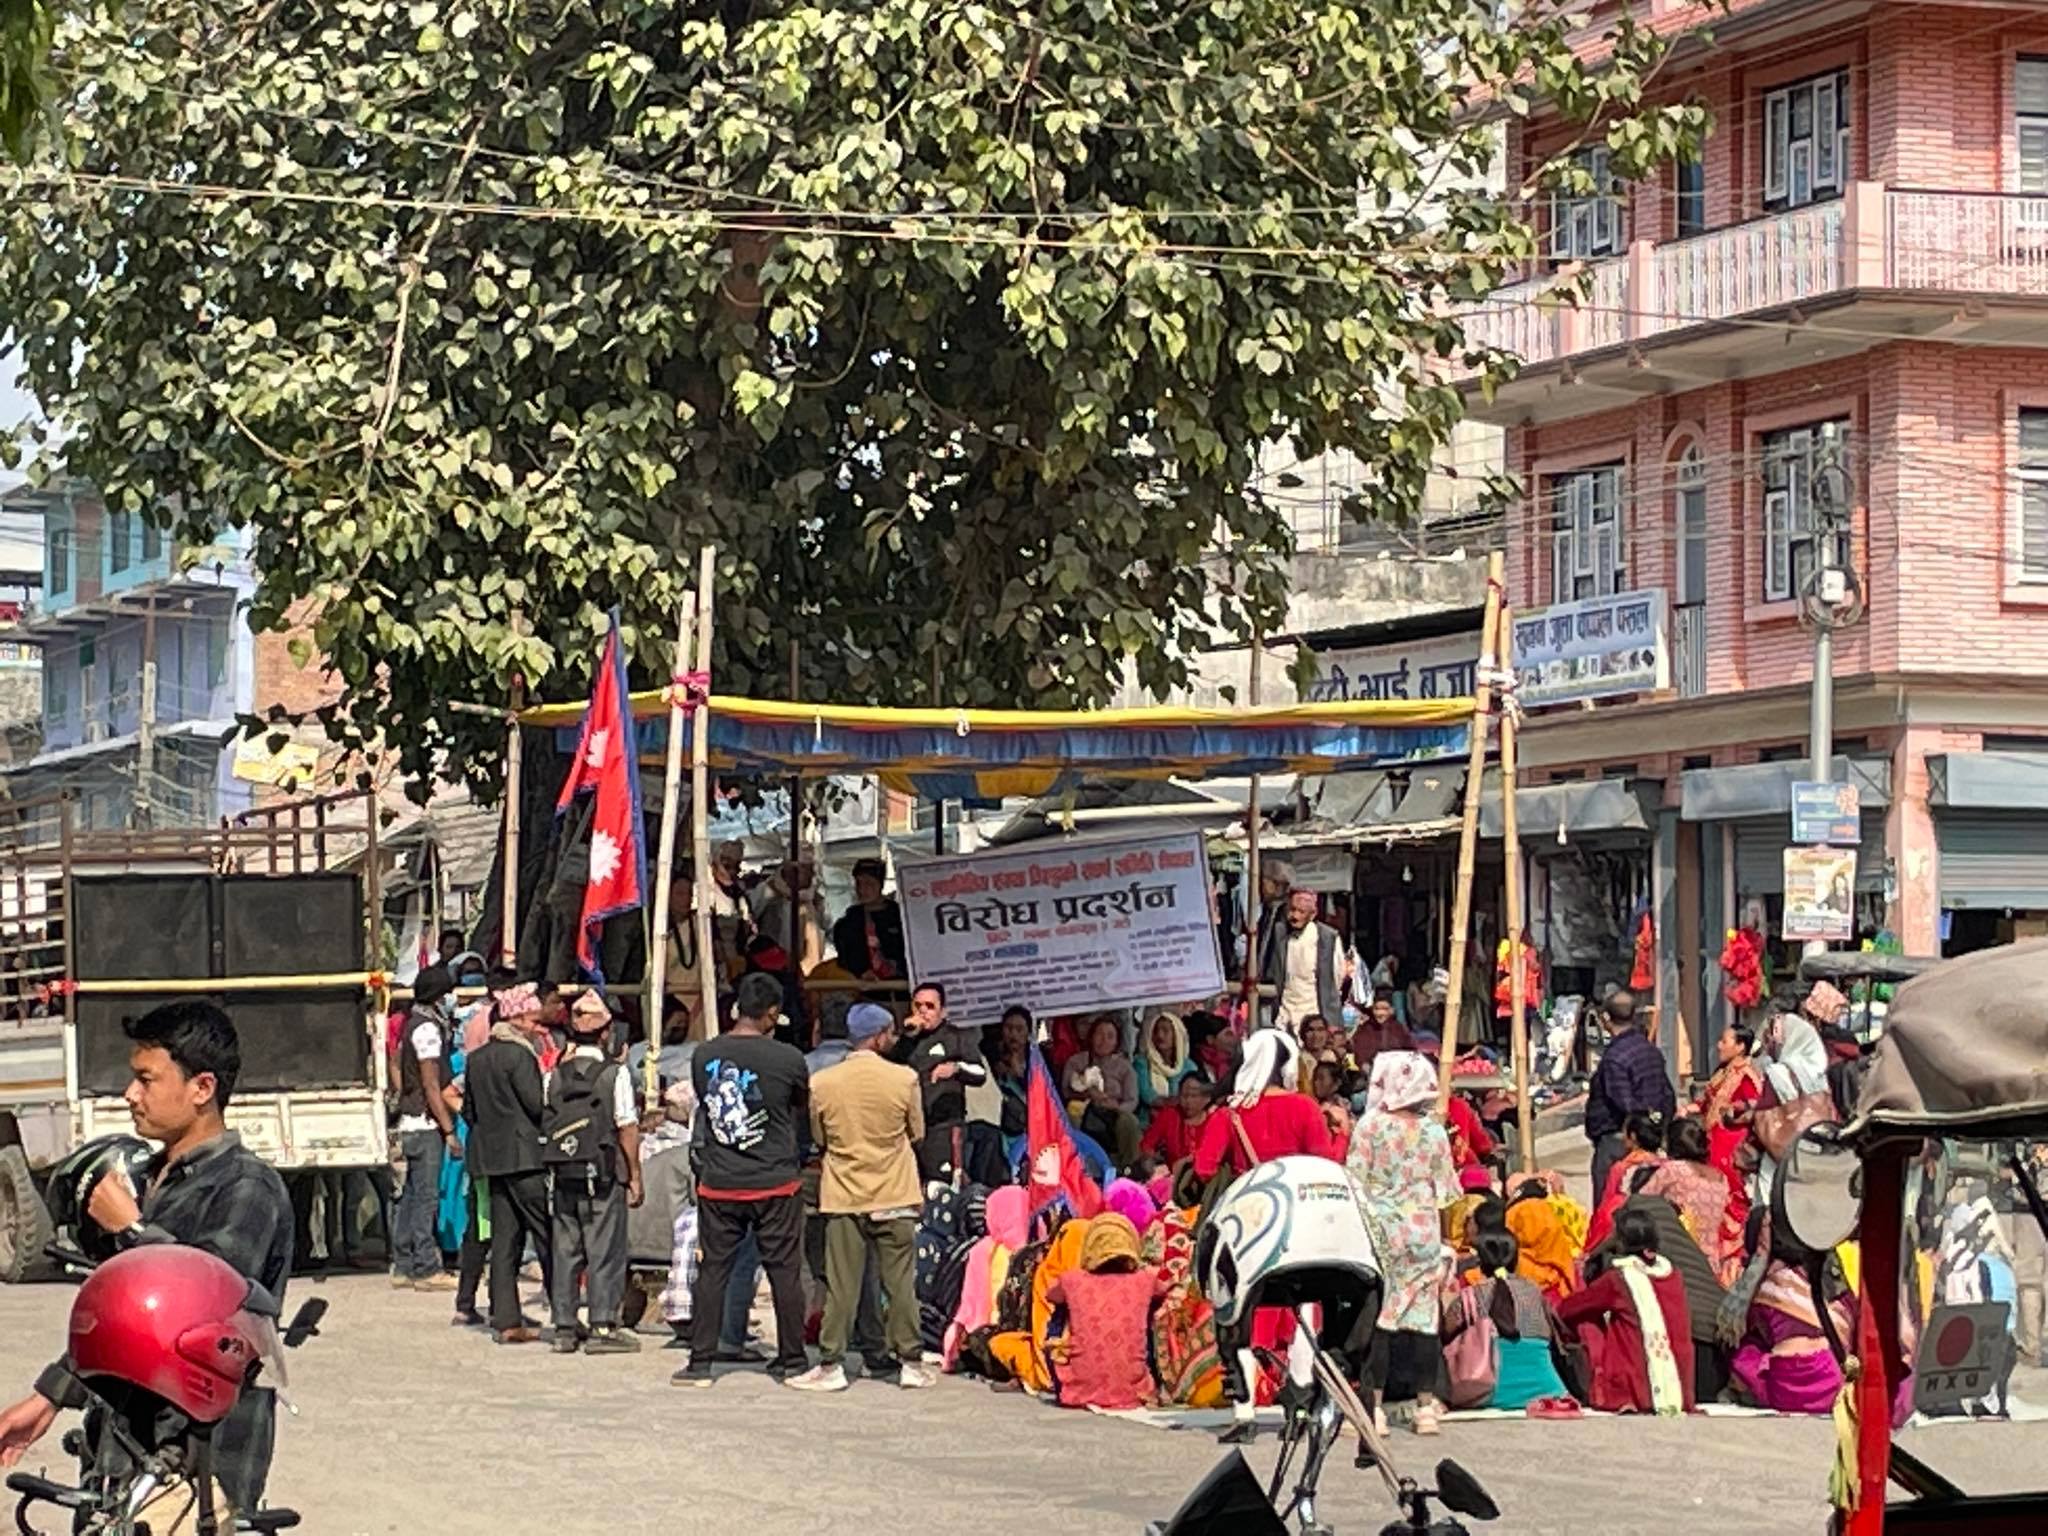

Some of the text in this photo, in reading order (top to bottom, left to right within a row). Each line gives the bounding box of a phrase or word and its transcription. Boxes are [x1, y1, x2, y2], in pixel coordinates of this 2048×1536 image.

[1419, 659, 1479, 700] बजा
[935, 897, 1039, 936] विरोध
[1054, 881, 1177, 925] प्रदर्शन
